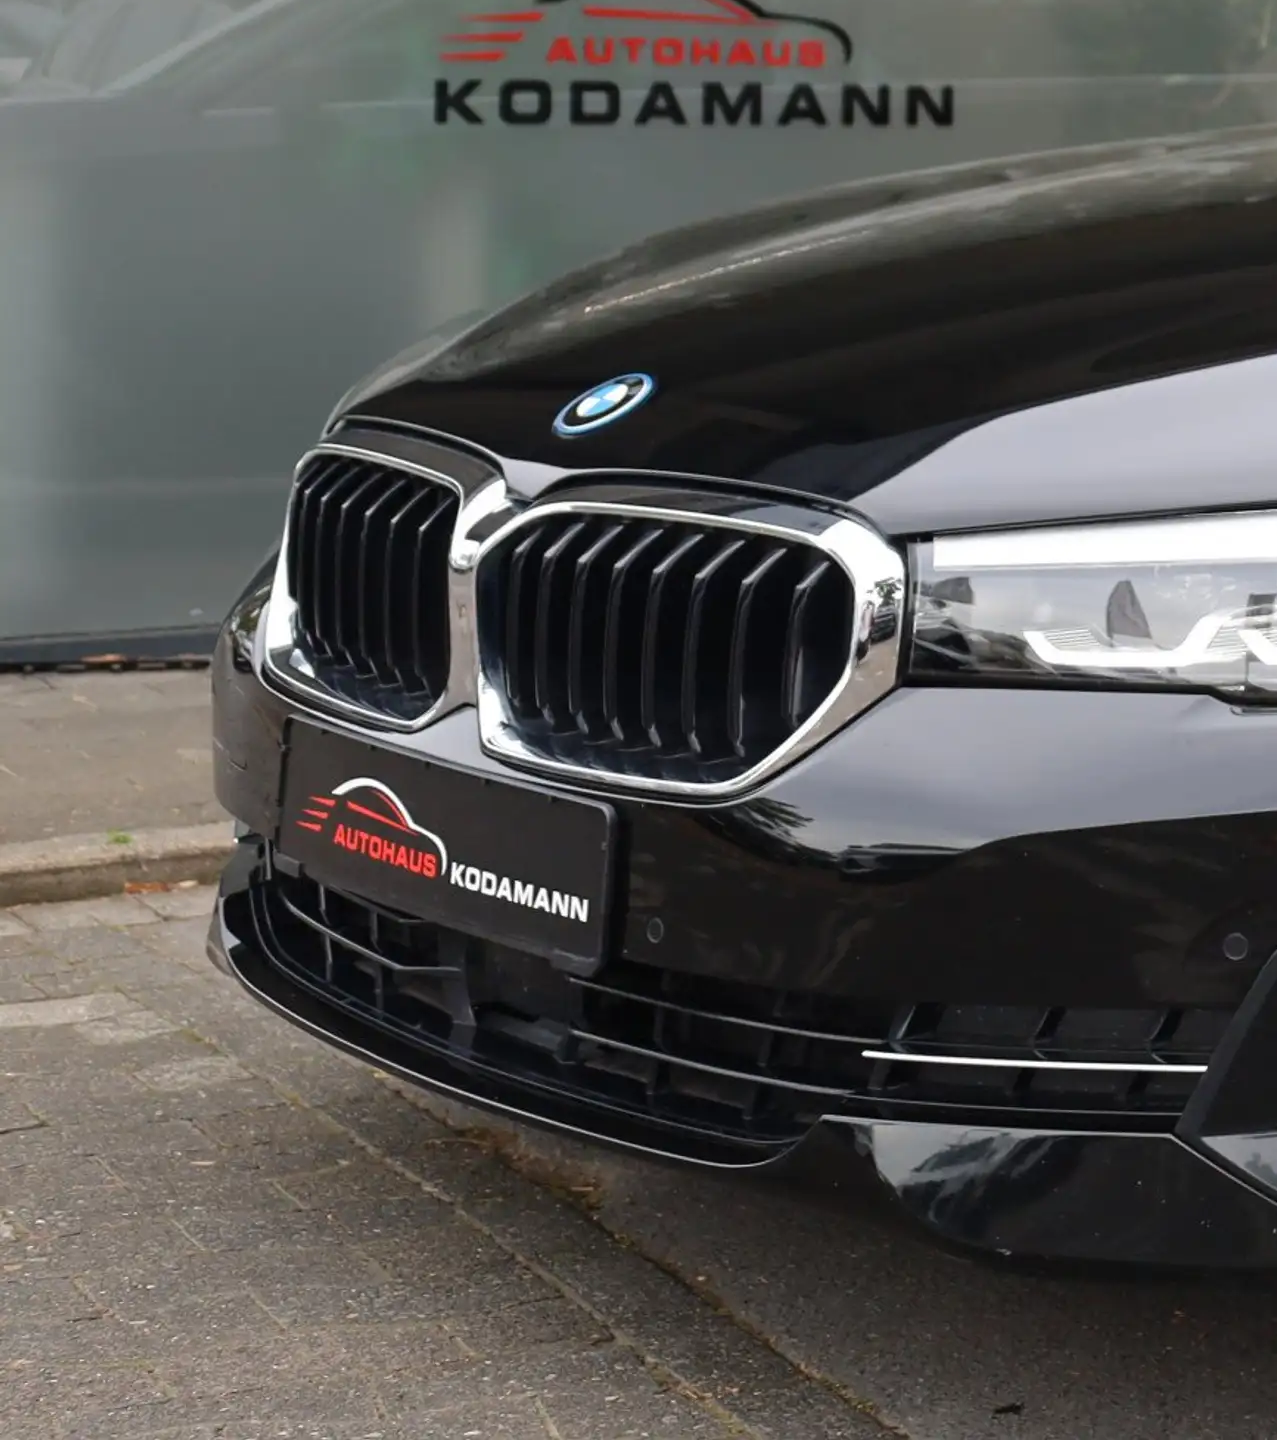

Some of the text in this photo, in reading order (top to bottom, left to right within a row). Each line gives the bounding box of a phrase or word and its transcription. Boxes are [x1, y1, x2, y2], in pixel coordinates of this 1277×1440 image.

[546, 35, 827, 68] AUTOHAUS
[433, 77, 955, 127] KODAMANN
[333, 822, 590, 923] AUTOHAUS KODAMANN
